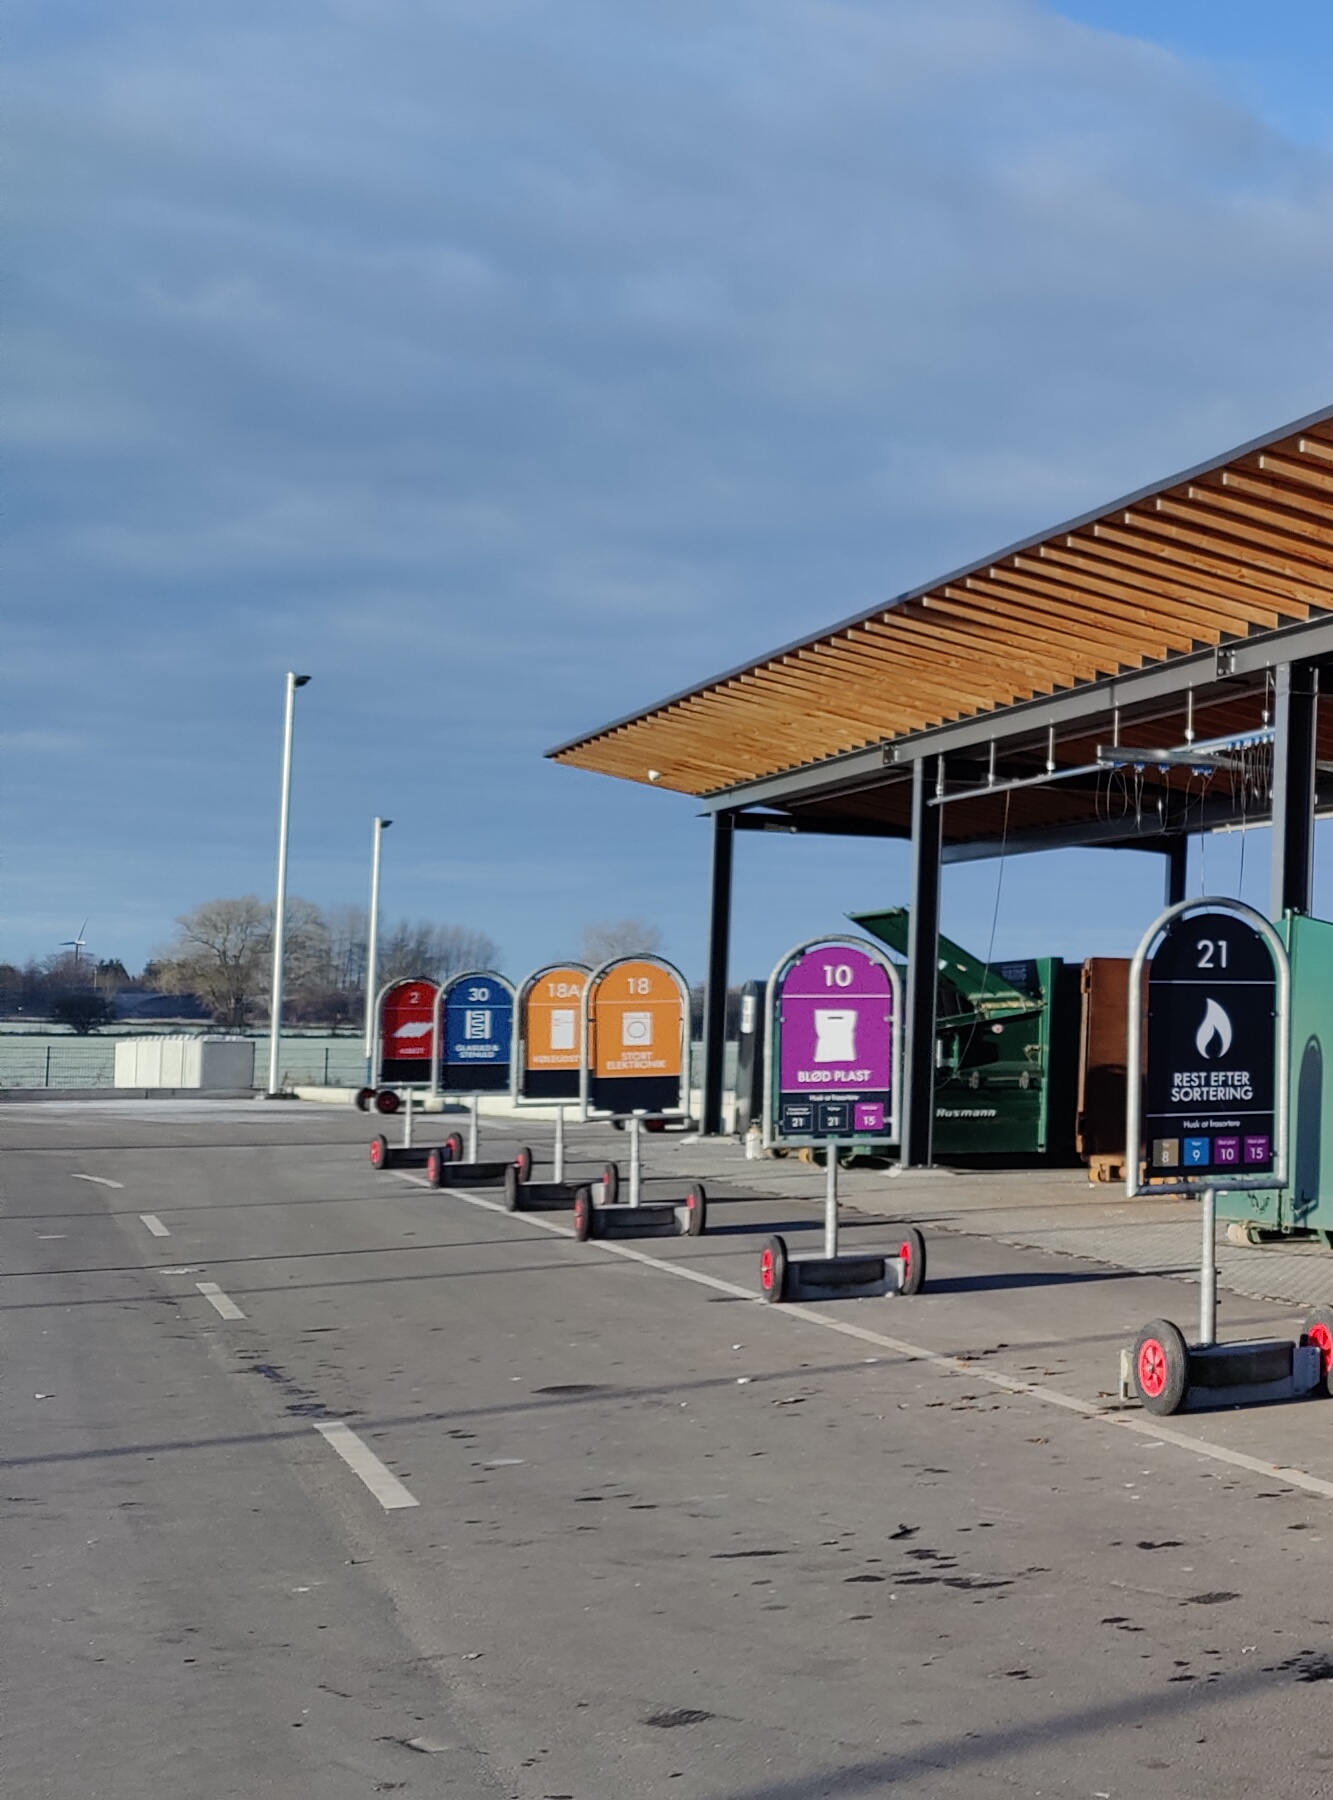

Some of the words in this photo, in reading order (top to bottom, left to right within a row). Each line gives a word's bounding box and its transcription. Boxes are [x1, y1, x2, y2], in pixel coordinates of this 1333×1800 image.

[1197, 940, 1228, 968] 21
[823, 965, 852, 987] 10
[548, 983, 580, 998] 18A
[627, 977, 650, 995] 18
[409, 992, 420, 1004] 2
[468, 988, 490, 1002] 30
[797, 1071, 831, 1082] BLØD
[834, 1070, 872, 1082] PLAST
[1174, 1072, 1207, 1086] REST
[1210, 1071, 1250, 1086] EFTER
[1171, 1086, 1253, 1102] SORTERING
[792, 1118, 804, 1128] 21
[828, 1116, 839, 1126] 21
[864, 1116, 876, 1126] 15
[1162, 1151, 1170, 1163] 8
[1192, 1150, 1200, 1161] 9
[1221, 1148, 1234, 1160] 10
[1251, 1148, 1264, 1160] 15
